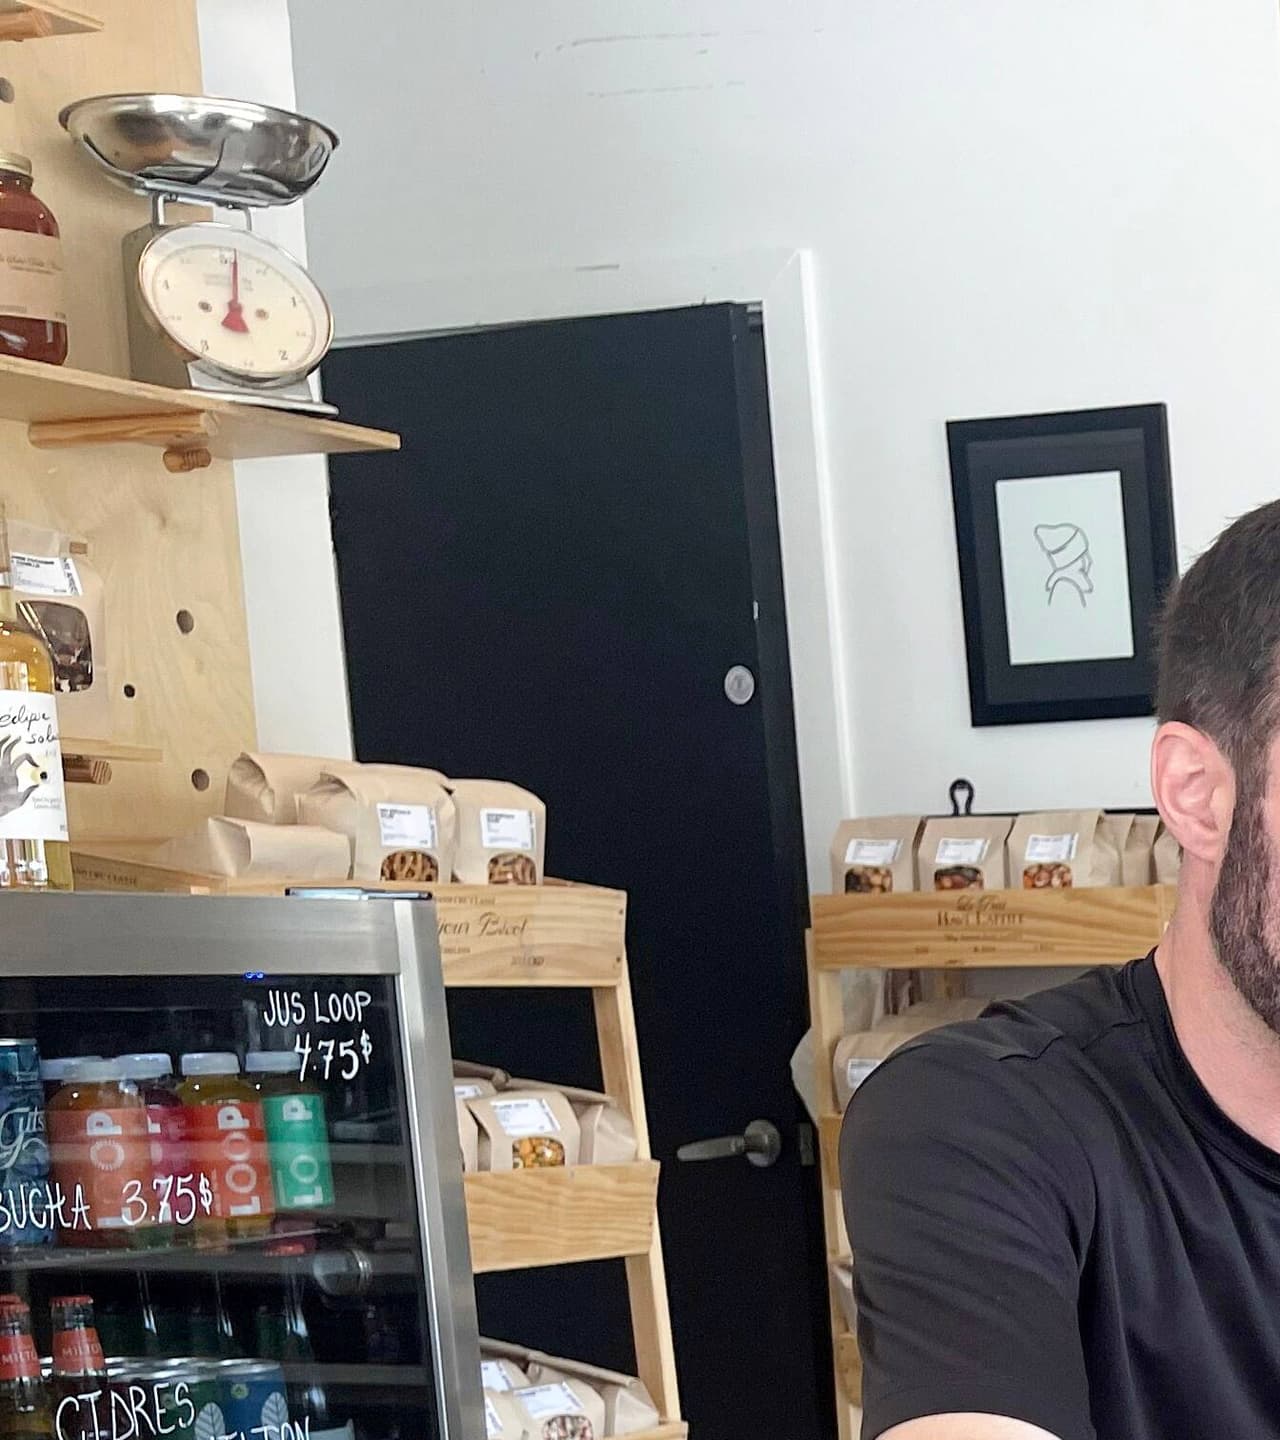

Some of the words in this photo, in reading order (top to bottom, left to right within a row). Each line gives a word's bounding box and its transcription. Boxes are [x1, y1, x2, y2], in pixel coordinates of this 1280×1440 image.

[264, 990, 306, 1027] JUS
[314, 990, 372, 1023] LOOP
[294, 1029, 373, 1082] 4.75$
[217, 1105, 261, 1216] LOOP
[282, 1098, 324, 1205] LOP
[121, 1172, 213, 1226] 3.75$
